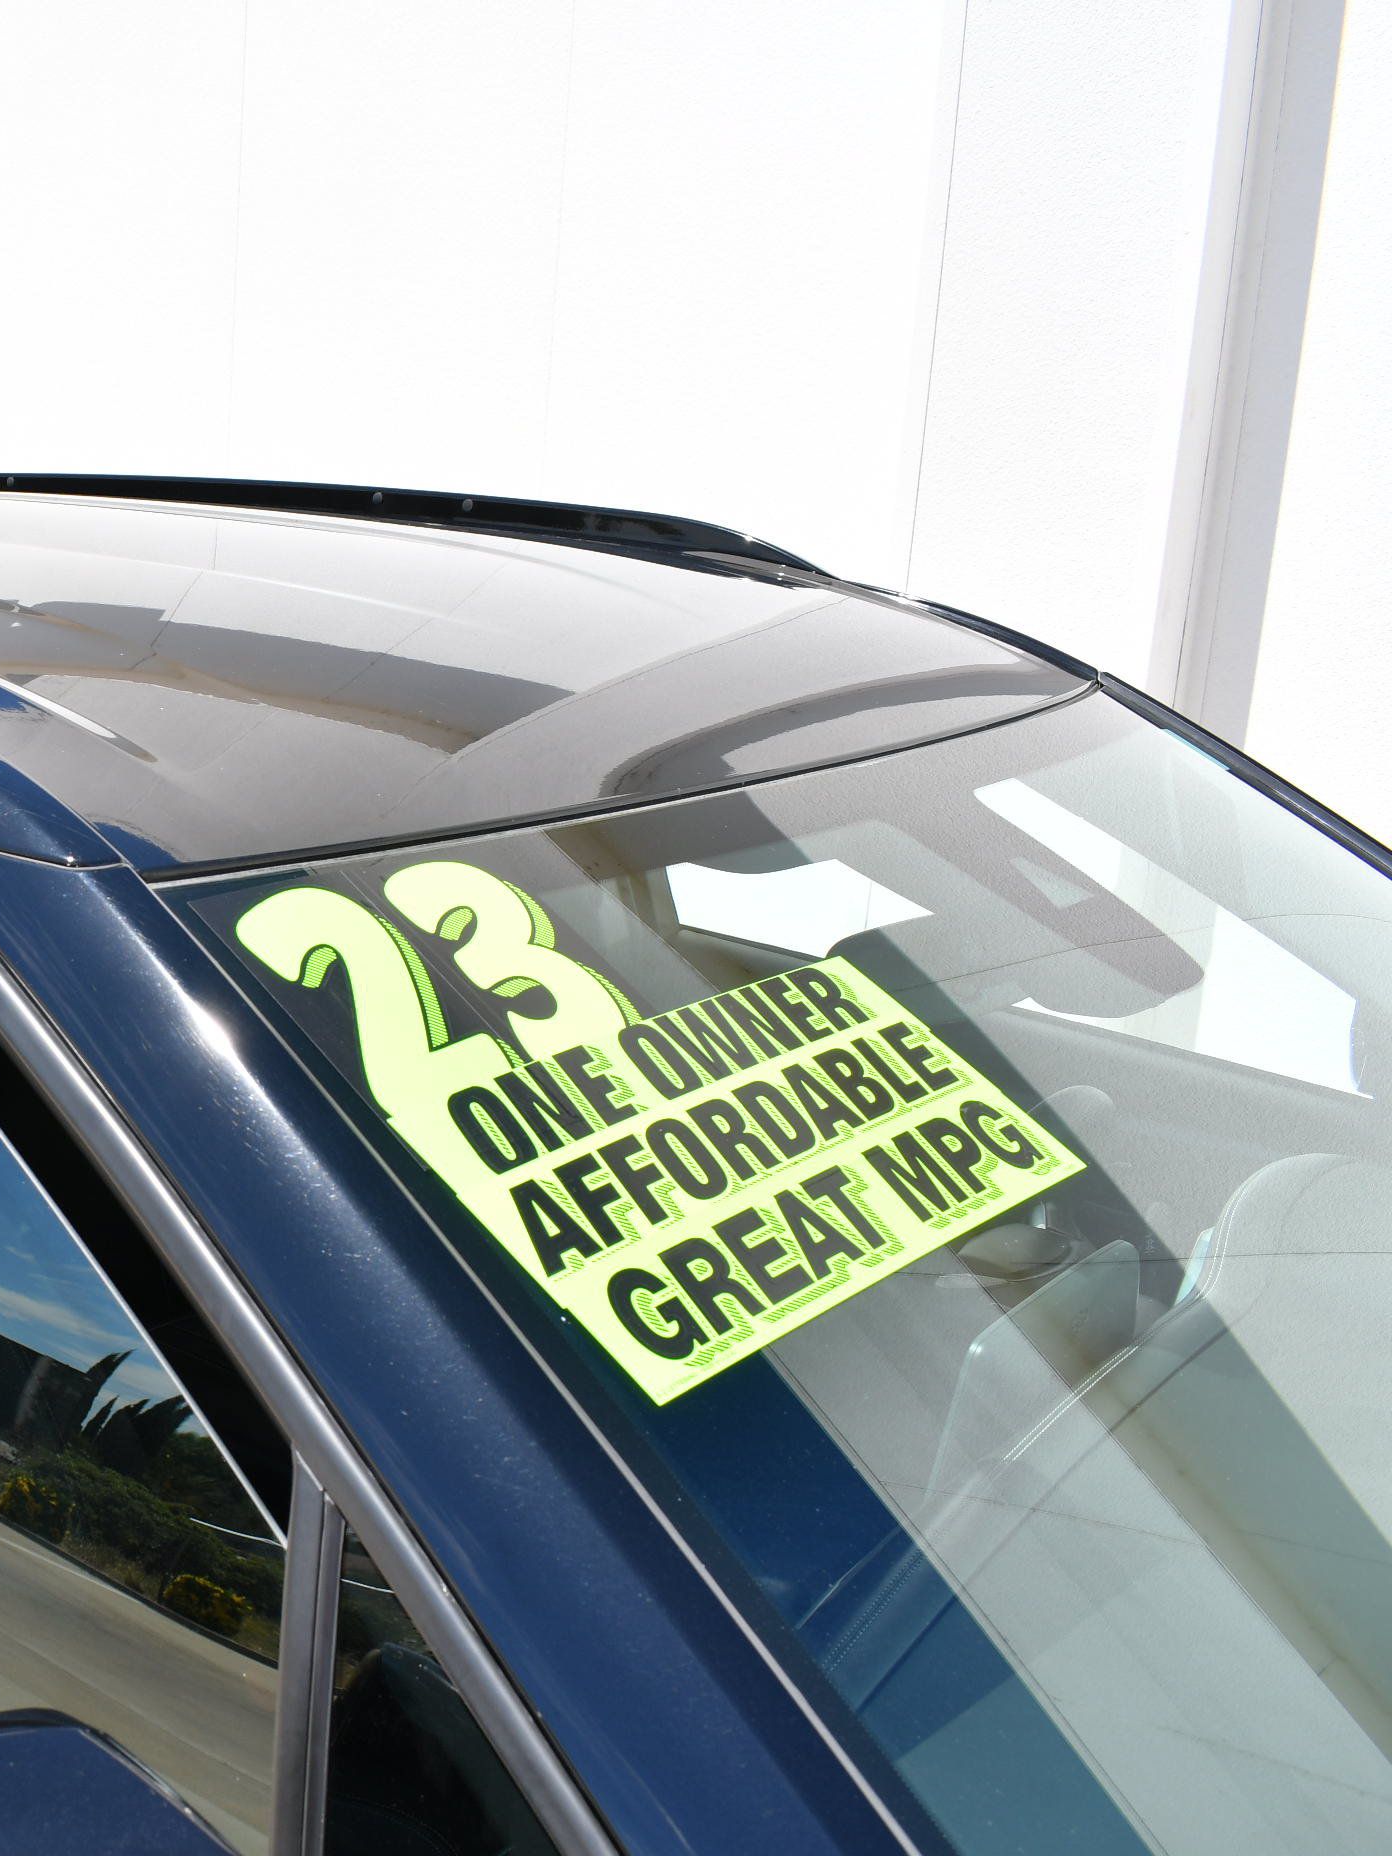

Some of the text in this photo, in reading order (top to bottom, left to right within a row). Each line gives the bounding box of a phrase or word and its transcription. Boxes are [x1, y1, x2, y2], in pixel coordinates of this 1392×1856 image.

[235, 860, 638, 1118] 23
[446, 966, 866, 1175] ONE OWNER
[509, 1021, 961, 1278] AFFORDABLE
[607, 1099, 1042, 1360] GREAT MPG
